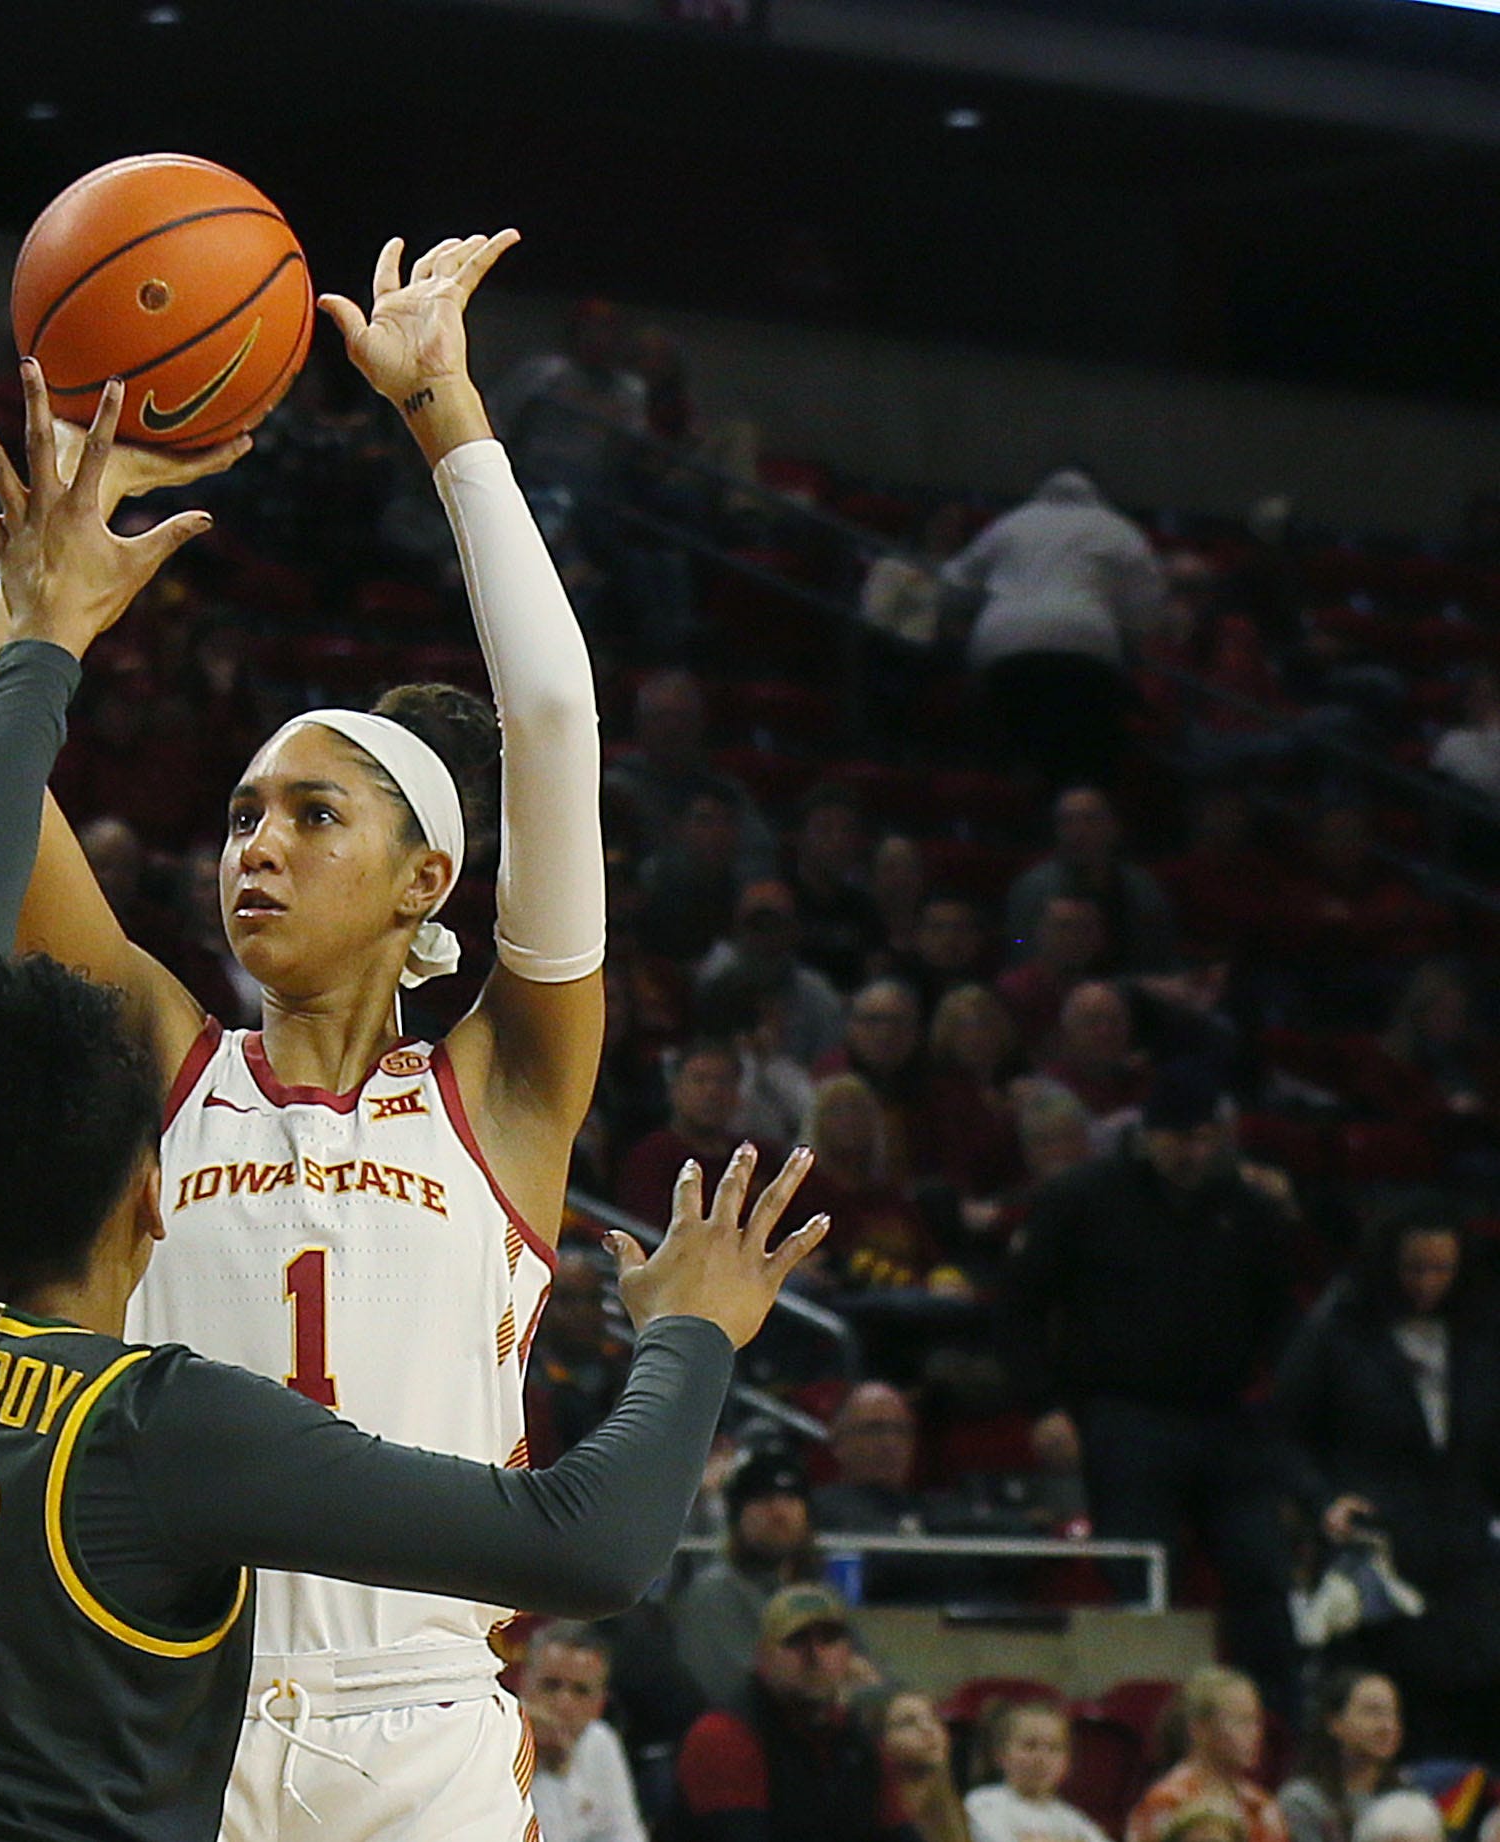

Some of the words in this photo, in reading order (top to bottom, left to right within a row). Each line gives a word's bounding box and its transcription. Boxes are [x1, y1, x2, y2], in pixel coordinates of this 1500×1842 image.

[173, 1160, 296, 1214] IOWA
[301, 1157, 449, 1219] STATE
[282, 1246, 339, 1411] 1
